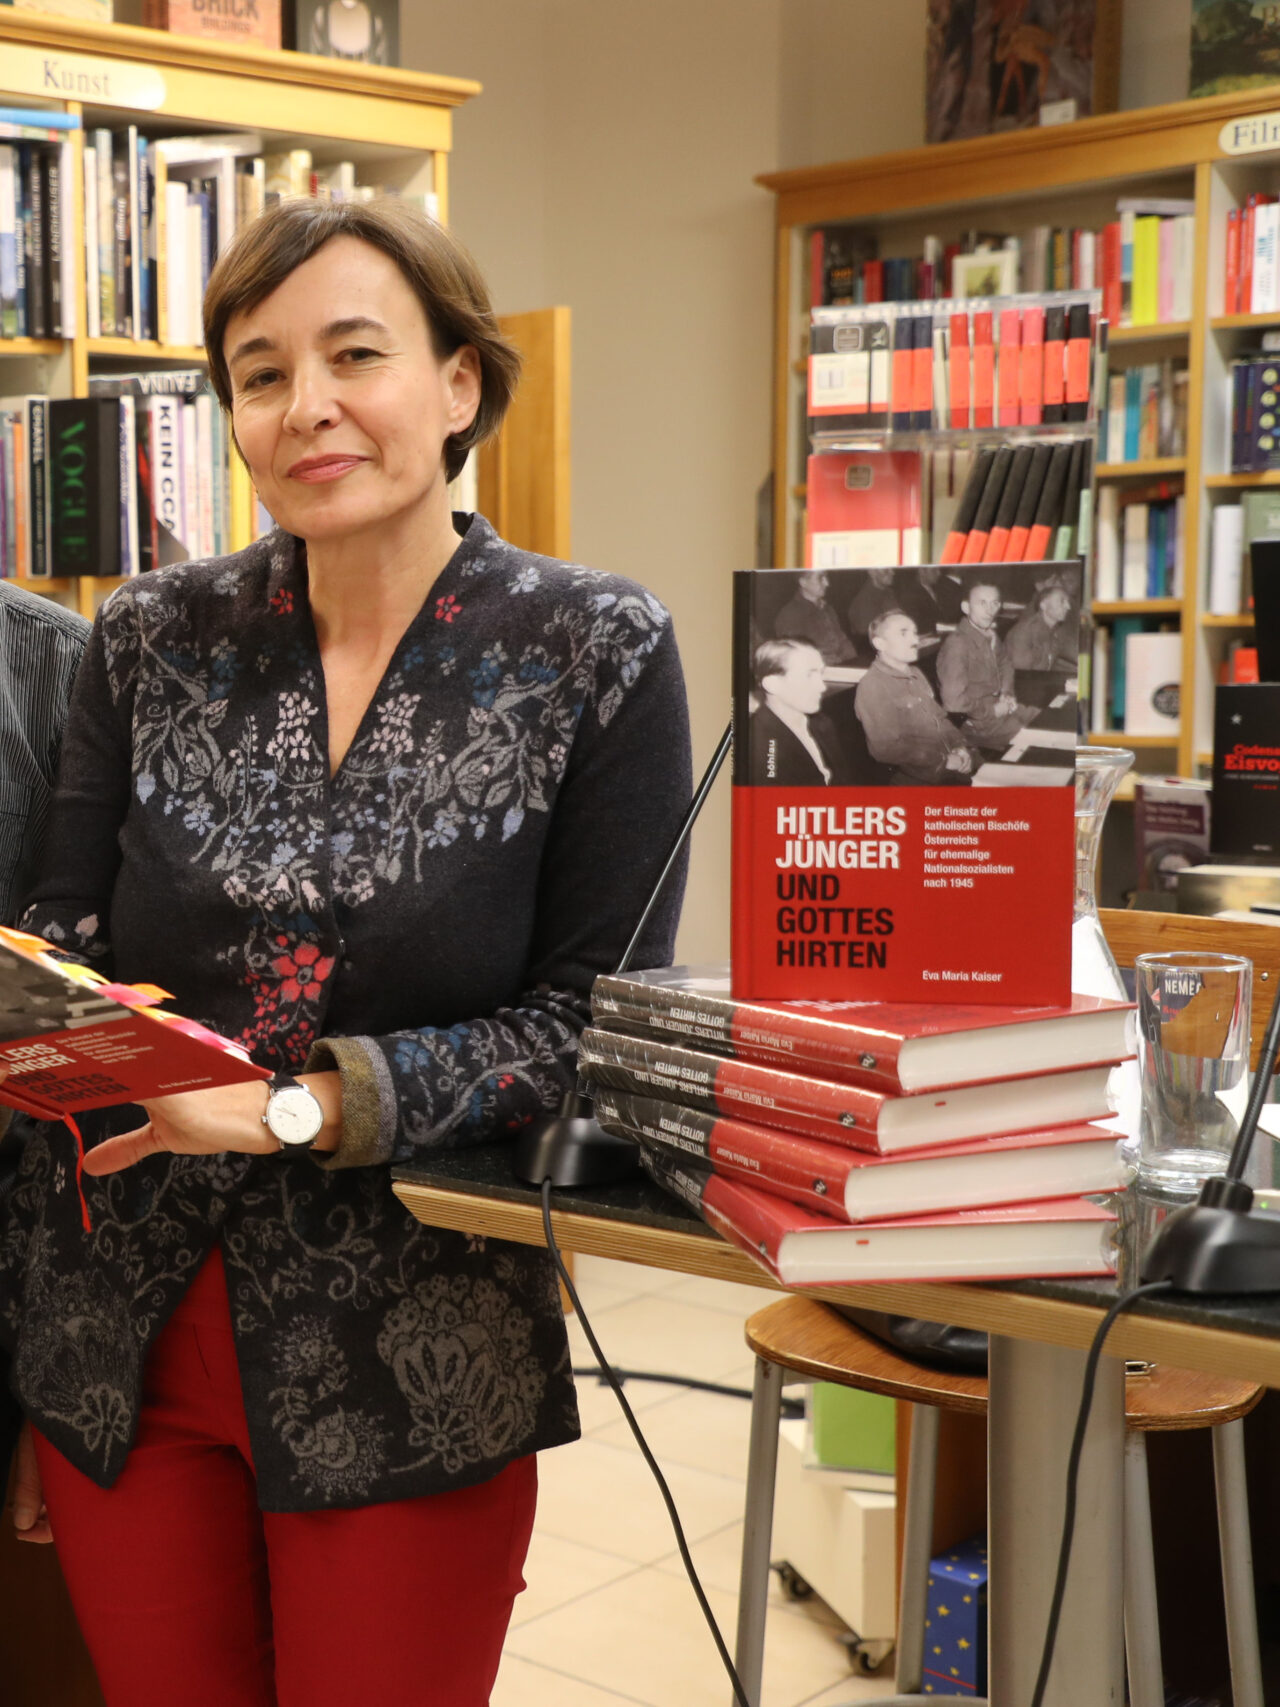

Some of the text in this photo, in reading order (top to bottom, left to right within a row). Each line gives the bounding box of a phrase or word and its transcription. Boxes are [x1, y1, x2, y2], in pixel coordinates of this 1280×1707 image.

[42, 59, 112, 97] Kunst
[32, 405, 44, 464] CHANEL
[159, 406, 173, 468] KEIN
[58, 420, 87, 562] VOGUE
[767, 739, 776, 778] böhlau
[1224, 753, 1280, 775] Eisvo
[776, 806, 907, 836] HITLERS
[924, 806, 998, 817] Der Einsatz der
[924, 820, 1030, 832] katholischen Bischöfe
[923, 834, 979, 846] Österreichs
[775, 834, 901, 869] JÜNGER
[924, 849, 990, 862] für ehemalige
[923, 863, 1015, 875] Nationalsozialisten
[776, 873, 841, 902] UND
[923, 877, 974, 889] nach 1945
[776, 906, 895, 936] GOTTES
[776, 940, 887, 969] HIRTEN
[922, 970, 1002, 983] Eva Maria Kaiser
[670, 1006, 725, 1027] GOTTES HIRTEN
[740, 1031, 793, 1050] Eva Maria Kaiser
[8, 1071, 58, 1087] UND
[654, 1061, 709, 1083] GOTTES HIRTEN
[28, 1072, 115, 1096] GOTTES
[48, 1084, 131, 1104] HIRTEN
[723, 1087, 775, 1107] Eva Maria Kaiser
[659, 1117, 705, 1142] GOTTES HIRTEN
